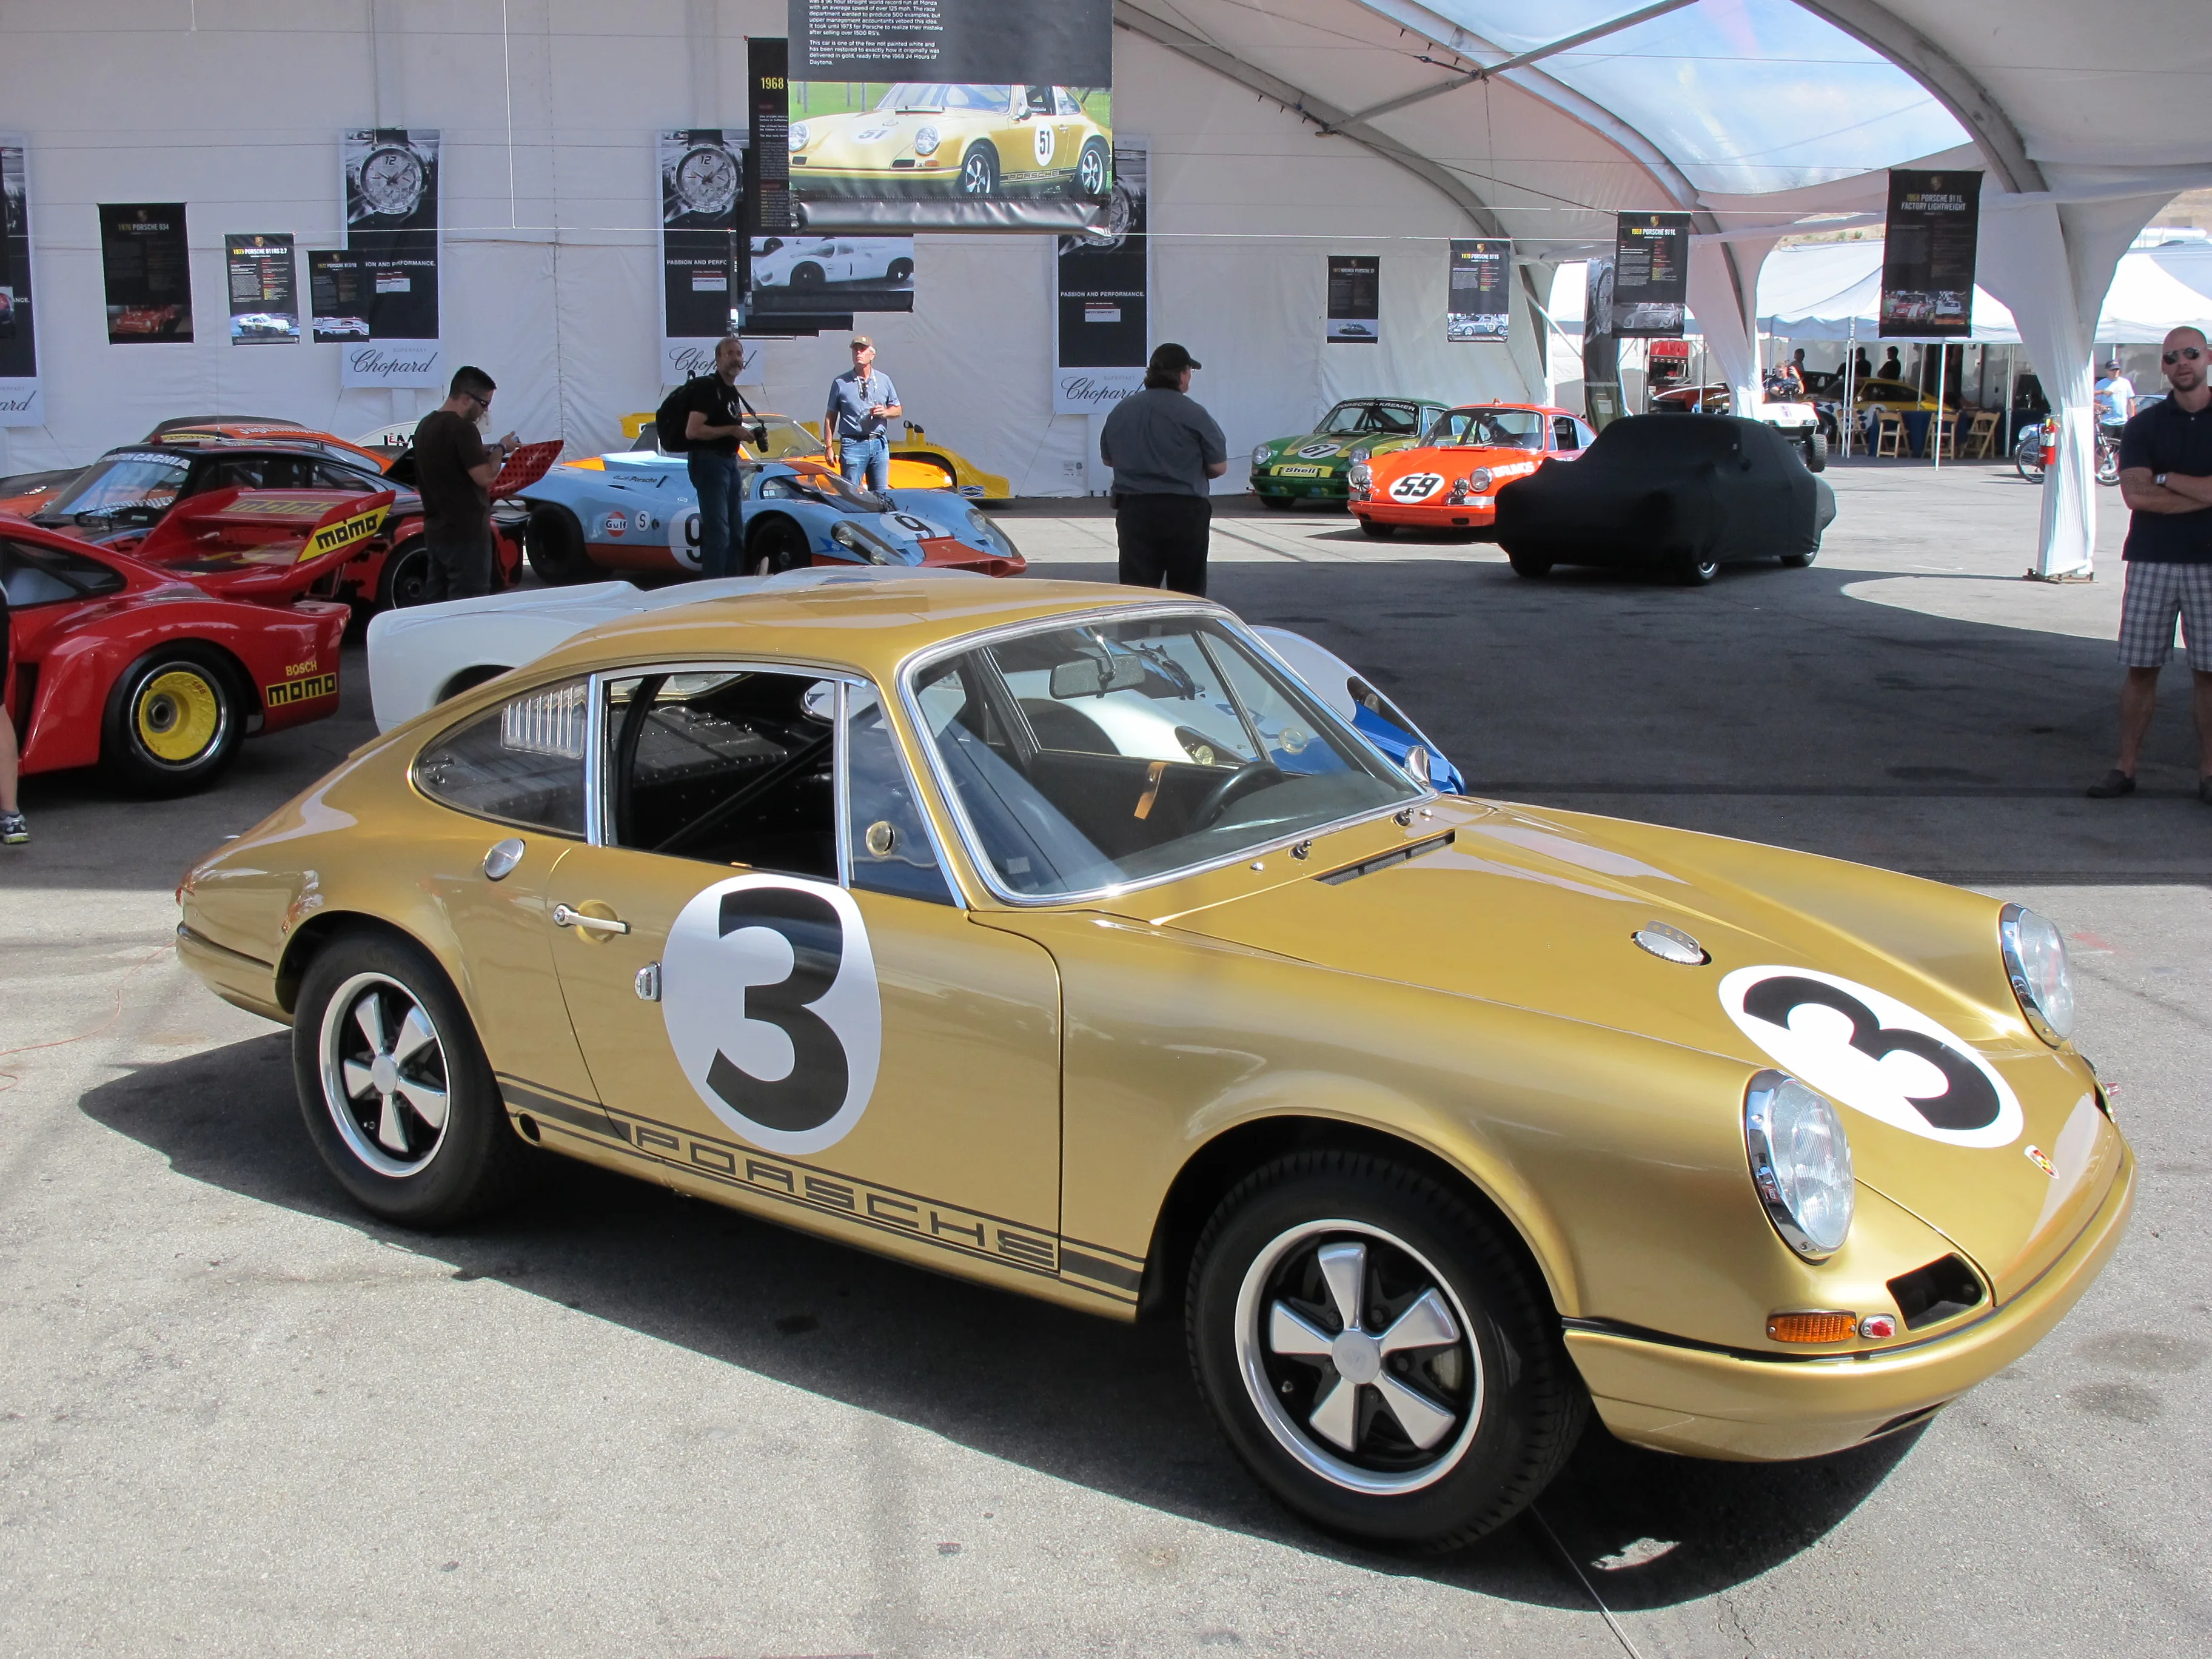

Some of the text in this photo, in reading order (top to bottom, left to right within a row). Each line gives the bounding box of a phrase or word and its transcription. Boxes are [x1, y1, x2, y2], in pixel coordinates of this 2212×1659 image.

[761, 77, 784, 89] 1968
[859, 129, 889, 139] 51
[1039, 130, 1050, 155] 51
[385, 156, 397, 166] 12
[700, 155, 712, 165] 12
[1009, 170, 1059, 180] PORSCHE
[1901, 202, 1966, 211] FACTORY LIGHTWEIGHT
[350, 349, 438, 378] Chopard
[669, 347, 757, 375] Chopd
[1379, 402, 1415, 412] KREMER
[1492, 461, 1535, 478] BRUMOS
[1393, 477, 1440, 497] 59
[606, 520, 628, 529] Gulf
[640, 514, 646, 528] S
[894, 515, 936, 540] 9
[315, 514, 379, 550] momo
[685, 512, 703, 564] 9
[286, 660, 317, 676] BOSCH
[267, 674, 336, 705] momo
[706, 886, 848, 1132] 3
[1743, 976, 2000, 1130] 3
[636, 1126, 1054, 1267] PORSCHE
